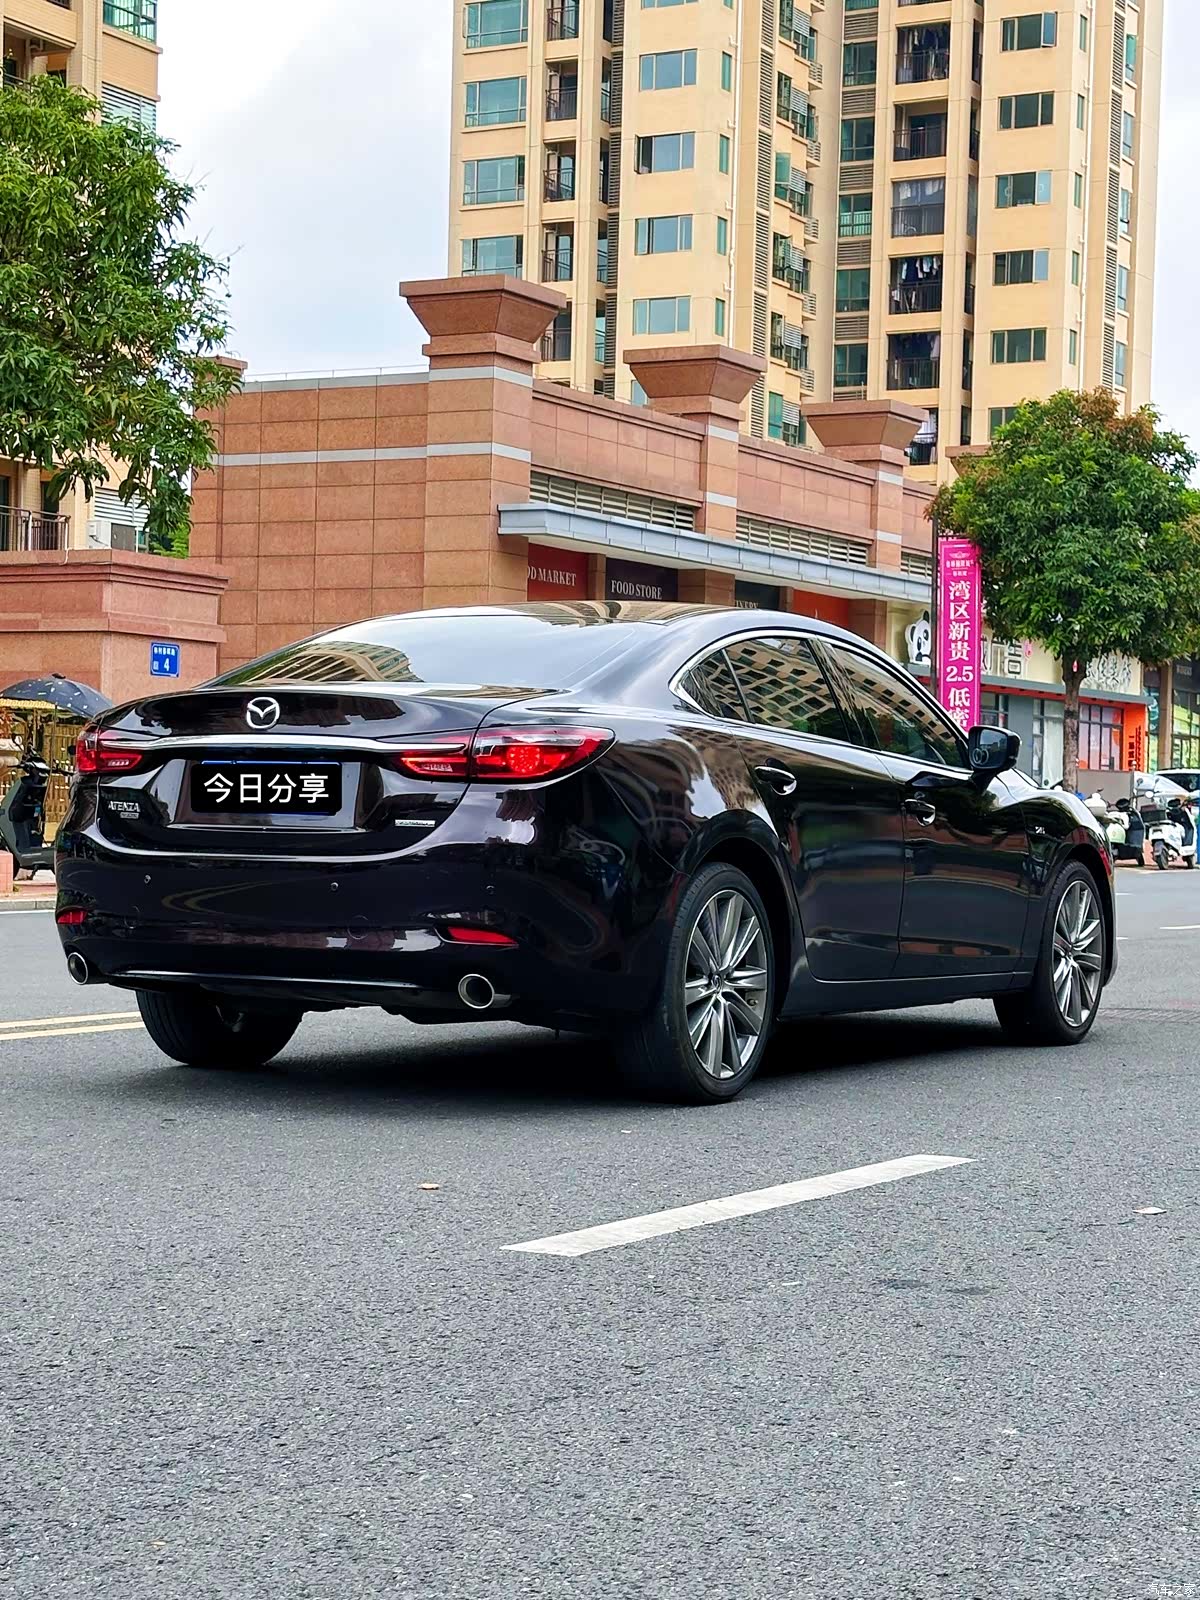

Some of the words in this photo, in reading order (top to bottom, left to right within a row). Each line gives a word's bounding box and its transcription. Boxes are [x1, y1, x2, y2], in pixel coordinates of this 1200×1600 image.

[538, 567, 576, 586] MARKET
[611, 580, 635, 595] FOOD
[635, 584, 663, 600] STORE
[164, 657, 170, 672] 4
